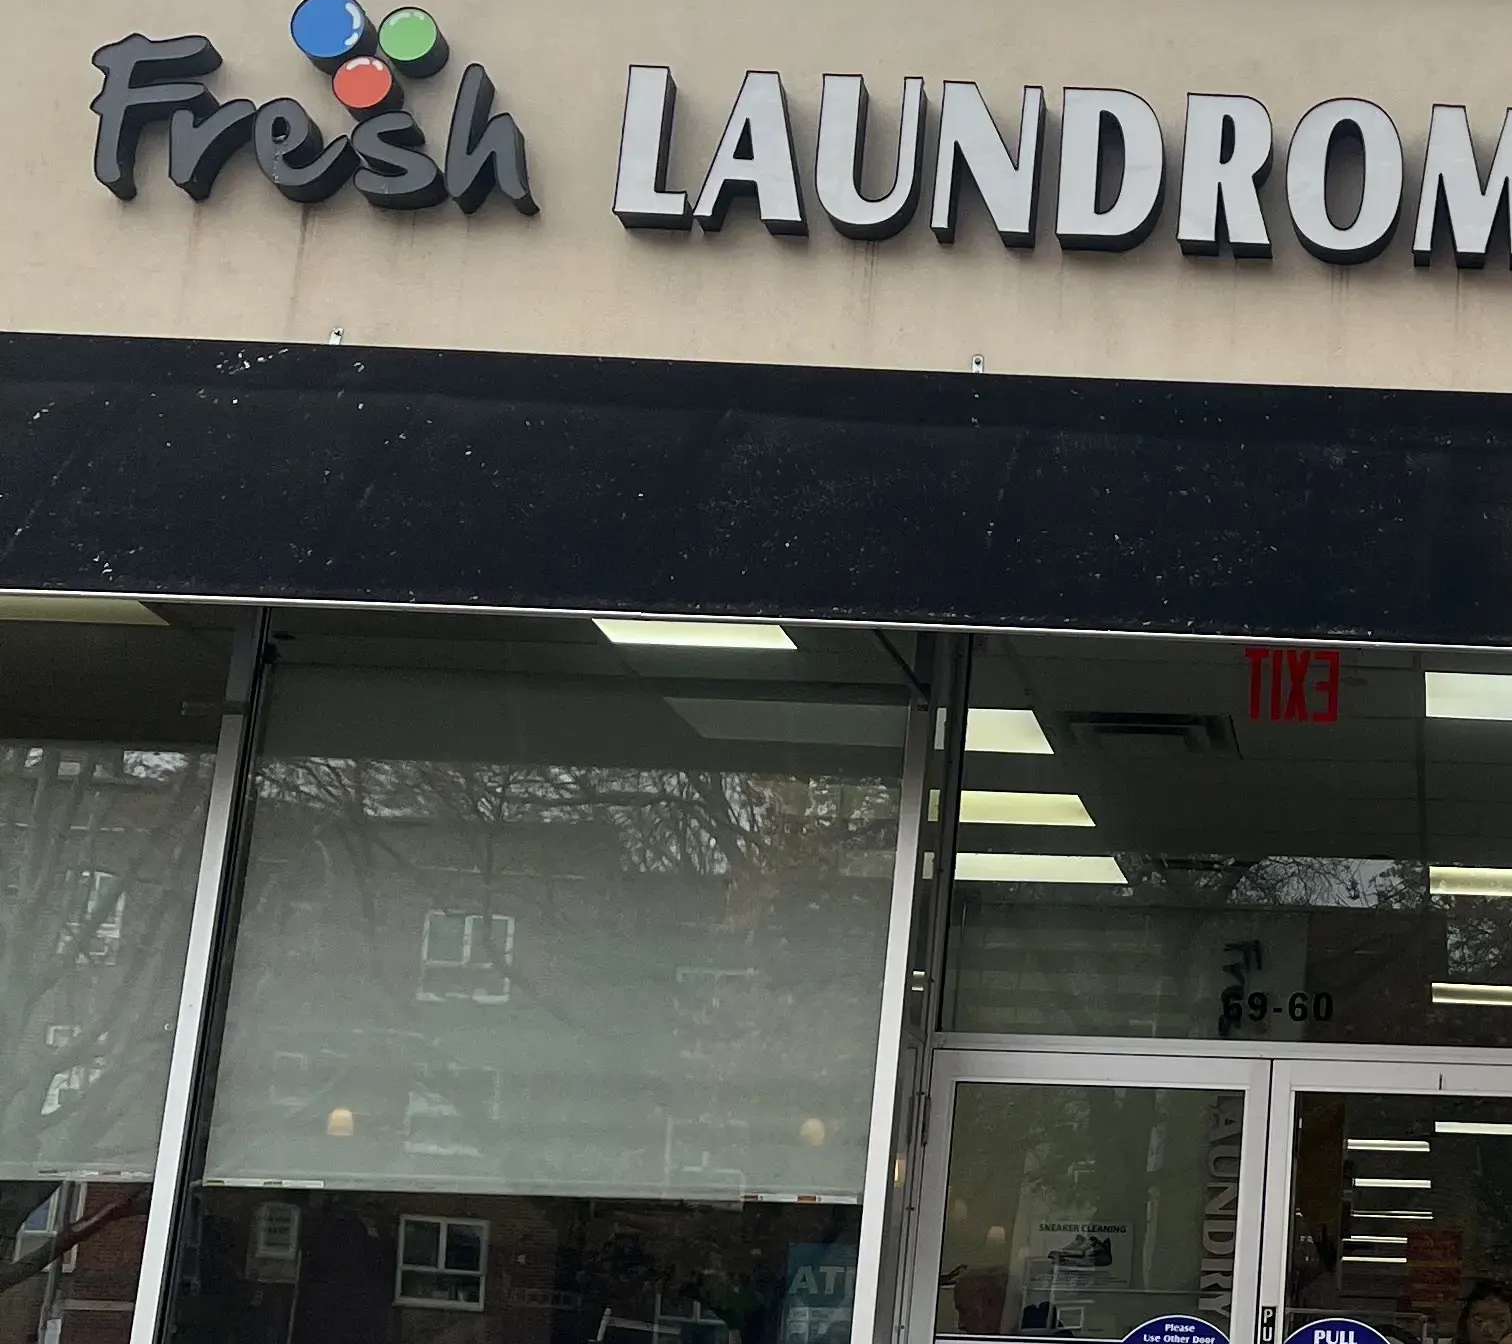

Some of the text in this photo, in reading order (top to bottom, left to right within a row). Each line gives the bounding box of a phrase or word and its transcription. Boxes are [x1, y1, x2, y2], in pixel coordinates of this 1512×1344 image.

[91, 33, 541, 215] Fresh
[1223, 991, 1334, 1022] 69-60
[1164, 1323, 1196, 1333] Please
[1143, 1334, 1216, 1344] Use Other Door
